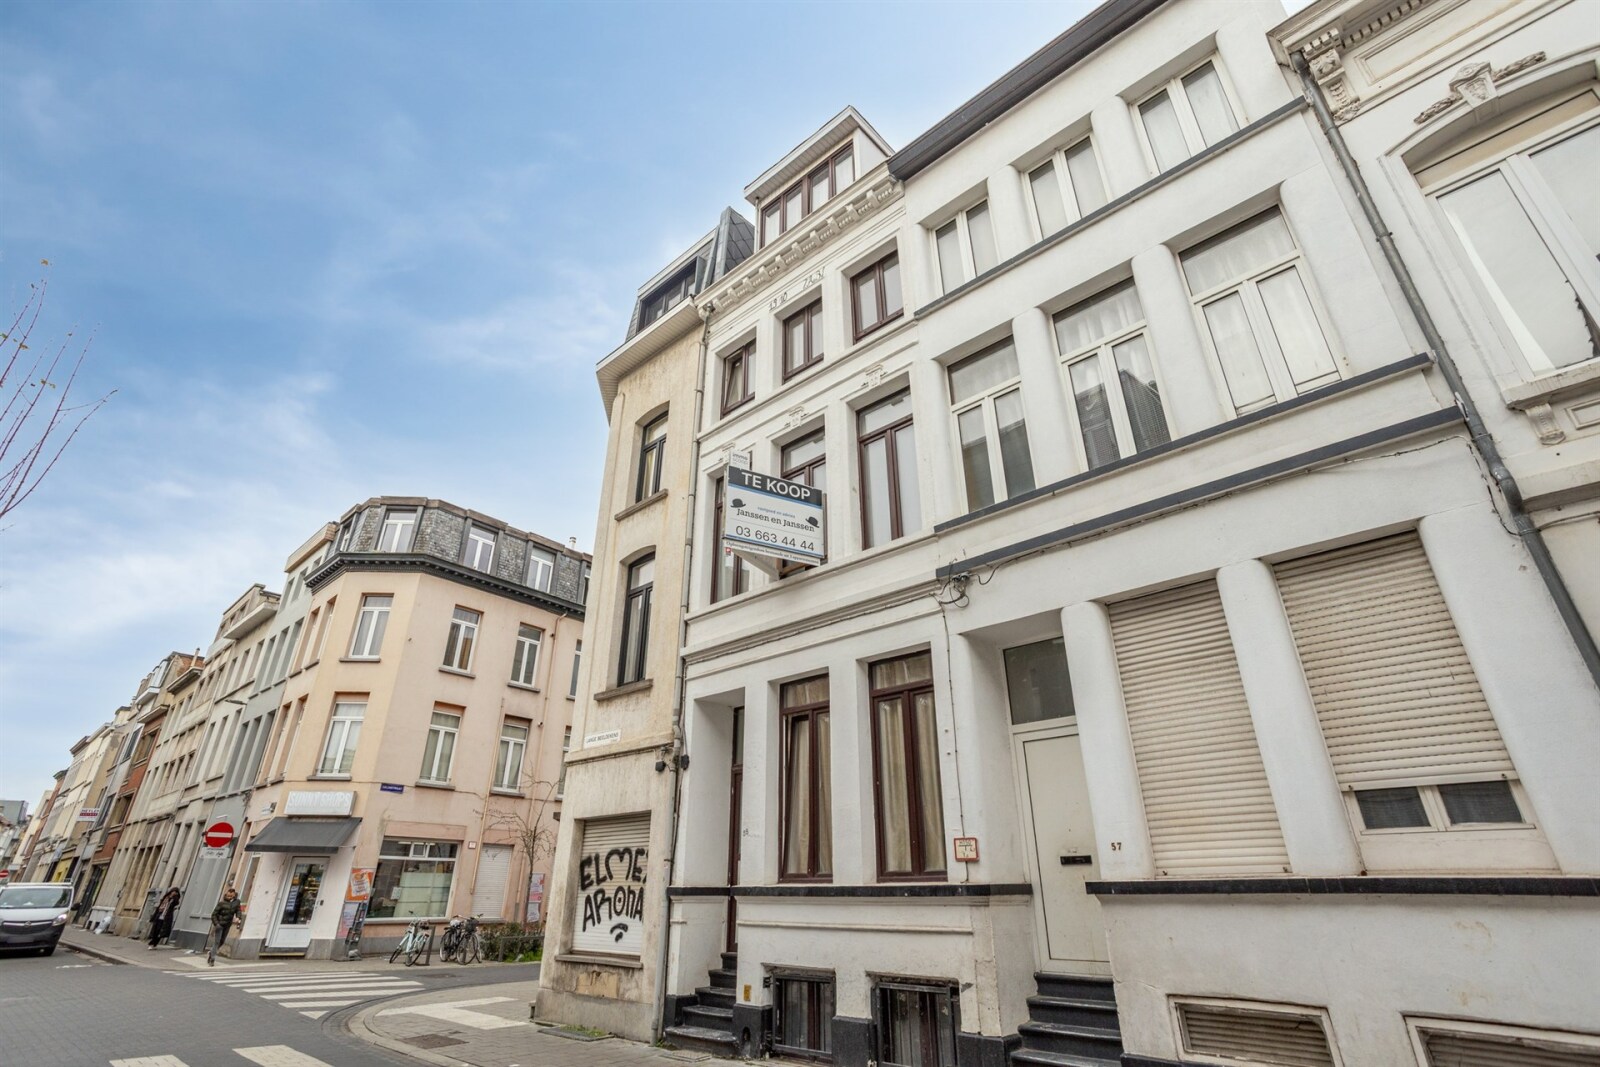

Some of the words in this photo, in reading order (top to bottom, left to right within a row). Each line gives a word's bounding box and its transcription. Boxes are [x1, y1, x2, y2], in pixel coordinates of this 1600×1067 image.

[741, 472, 761, 488] TE
[766, 478, 810, 499] KOOP
[736, 508, 769, 523] Janssen
[770, 516, 782, 525] en
[783, 519, 815, 532] Janssen
[735, 525, 751, 538] 03
[755, 530, 777, 543] 663
[781, 536, 796, 548] 44
[800, 541, 814, 551] 44
[1111, 842, 1121, 851] 57
[580, 847, 648, 891] ELME
